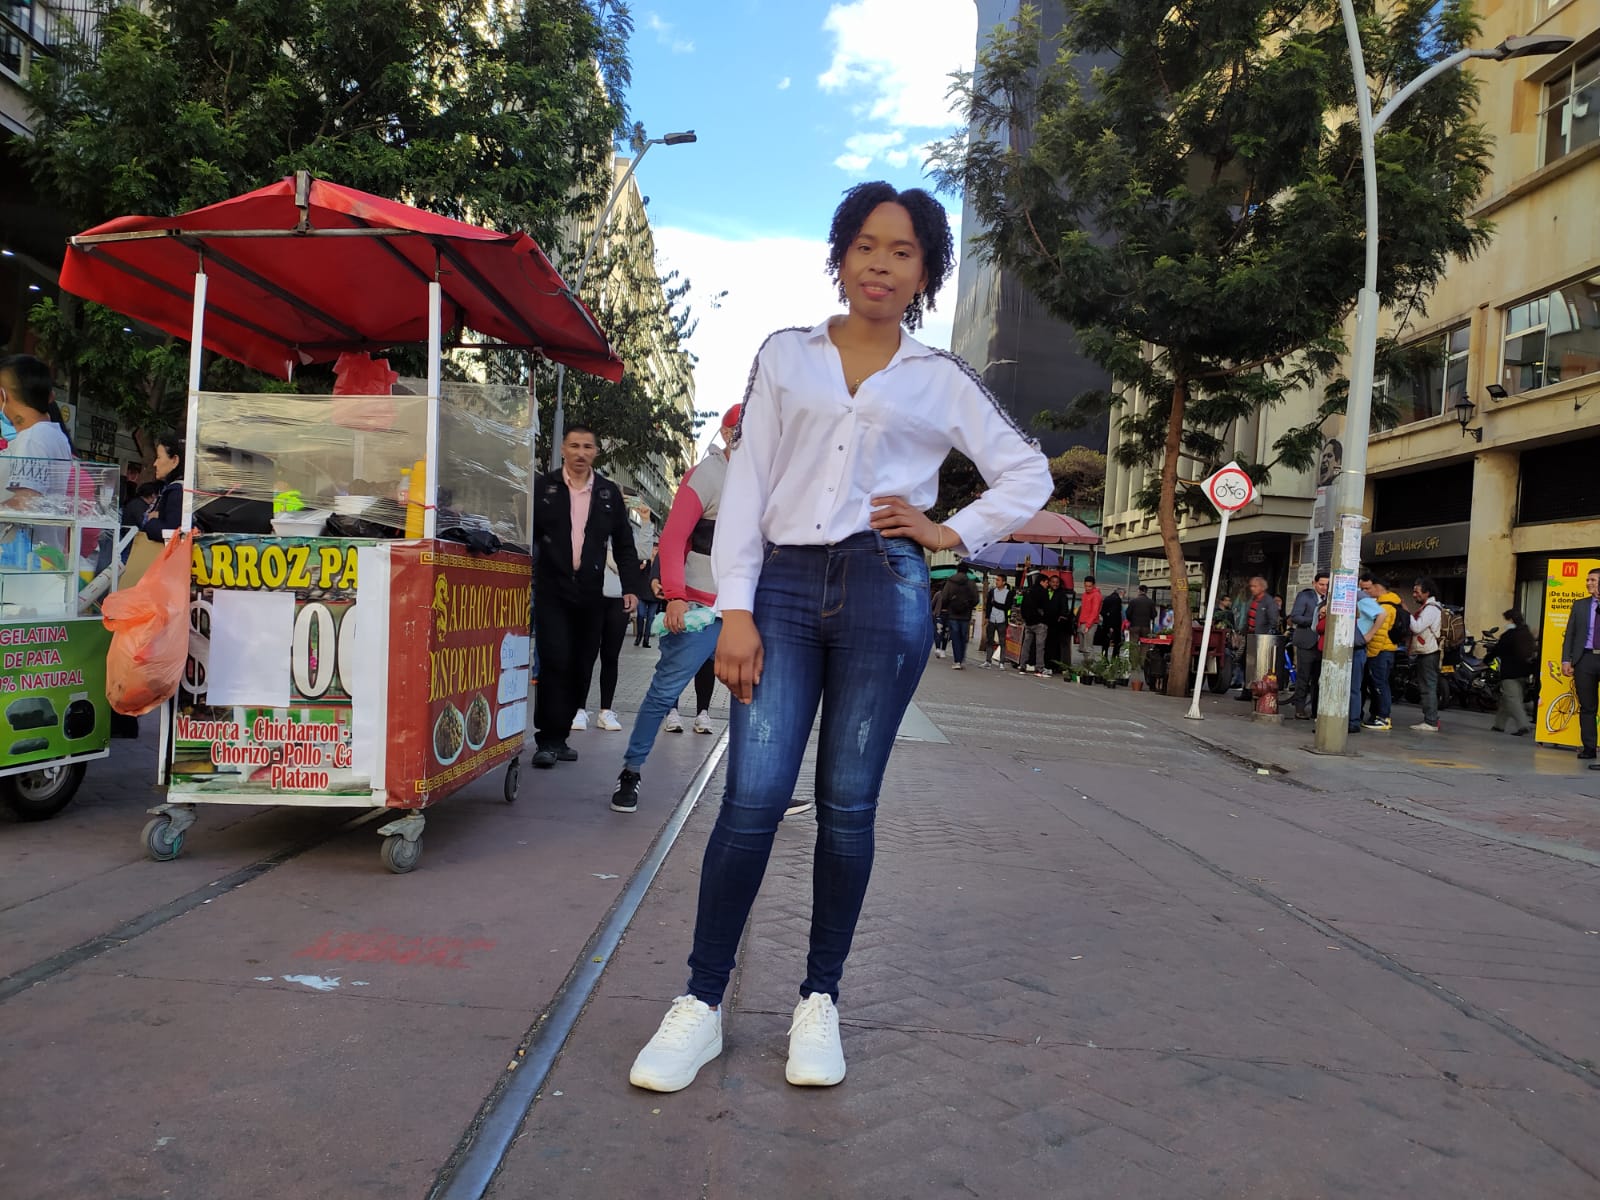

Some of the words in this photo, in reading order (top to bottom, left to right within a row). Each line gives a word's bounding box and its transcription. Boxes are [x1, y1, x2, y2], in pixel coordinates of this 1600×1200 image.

[191, 543, 312, 588] ARROZ
[448, 584, 492, 632] ARROZ
[0, 626, 68, 645] GELATINA
[4, 652, 23, 669] DE
[26, 649, 62, 667] PATA
[20, 669, 84, 691] NATURAL
[428, 643, 496, 702] ESPECIAL
[176, 715, 240, 741] Mazorca
[211, 741, 271, 765] Chorizo
[283, 742, 322, 766] Pollo
[271, 764, 329, 790] Platano
